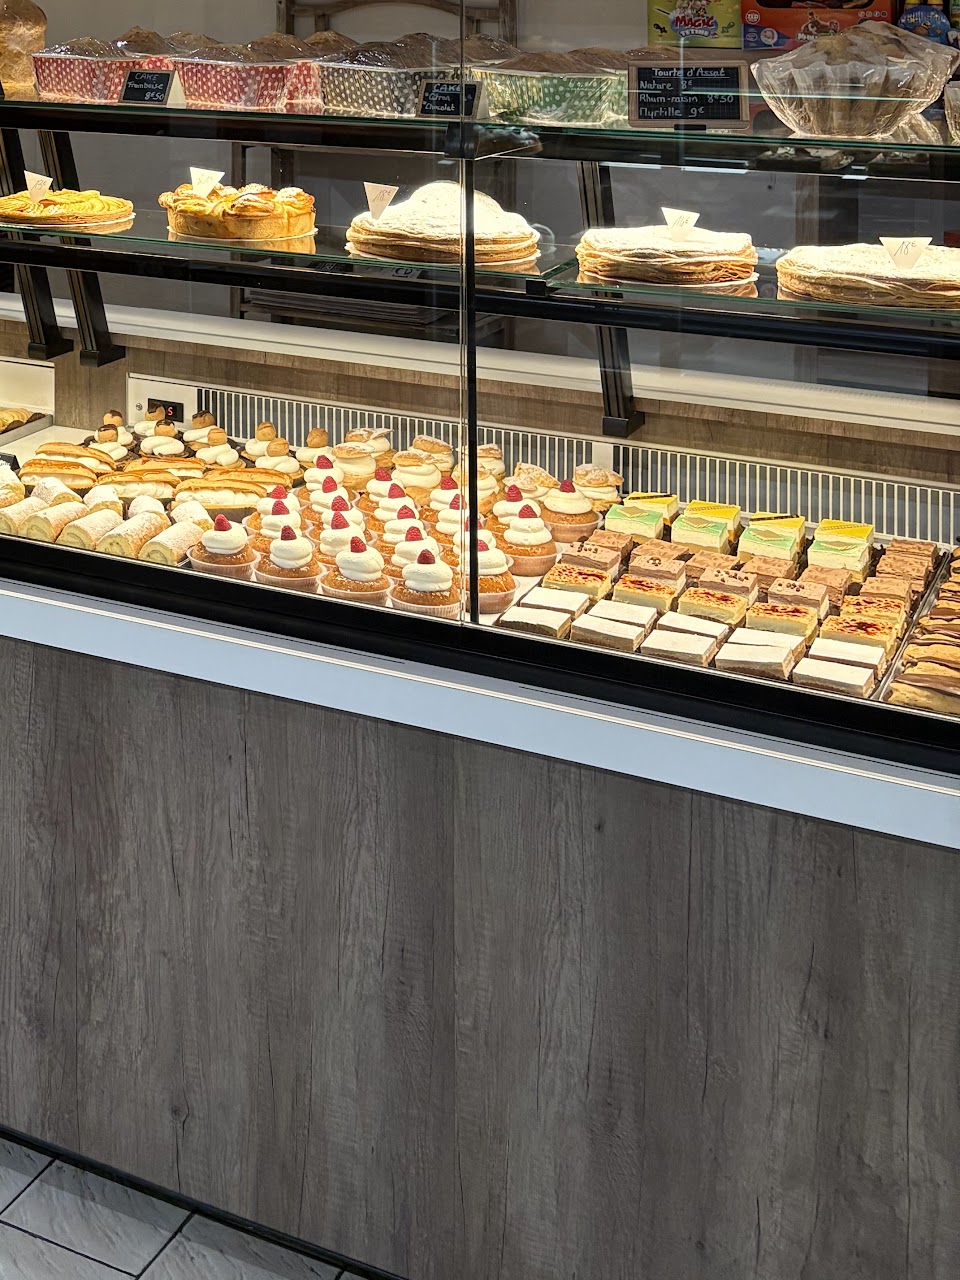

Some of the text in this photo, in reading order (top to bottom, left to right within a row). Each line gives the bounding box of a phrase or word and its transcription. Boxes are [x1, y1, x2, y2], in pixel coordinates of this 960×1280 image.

[674, 15, 715, 28] MAGIC
[135, 72, 159, 81] CAKE
[651, 67, 682, 77] Tourte
[639, 80, 673, 90] Nature
[428, 93, 451, 102] Citron
[425, 103, 455, 111] Chocolat
[640, 107, 682, 119] Myrtille
